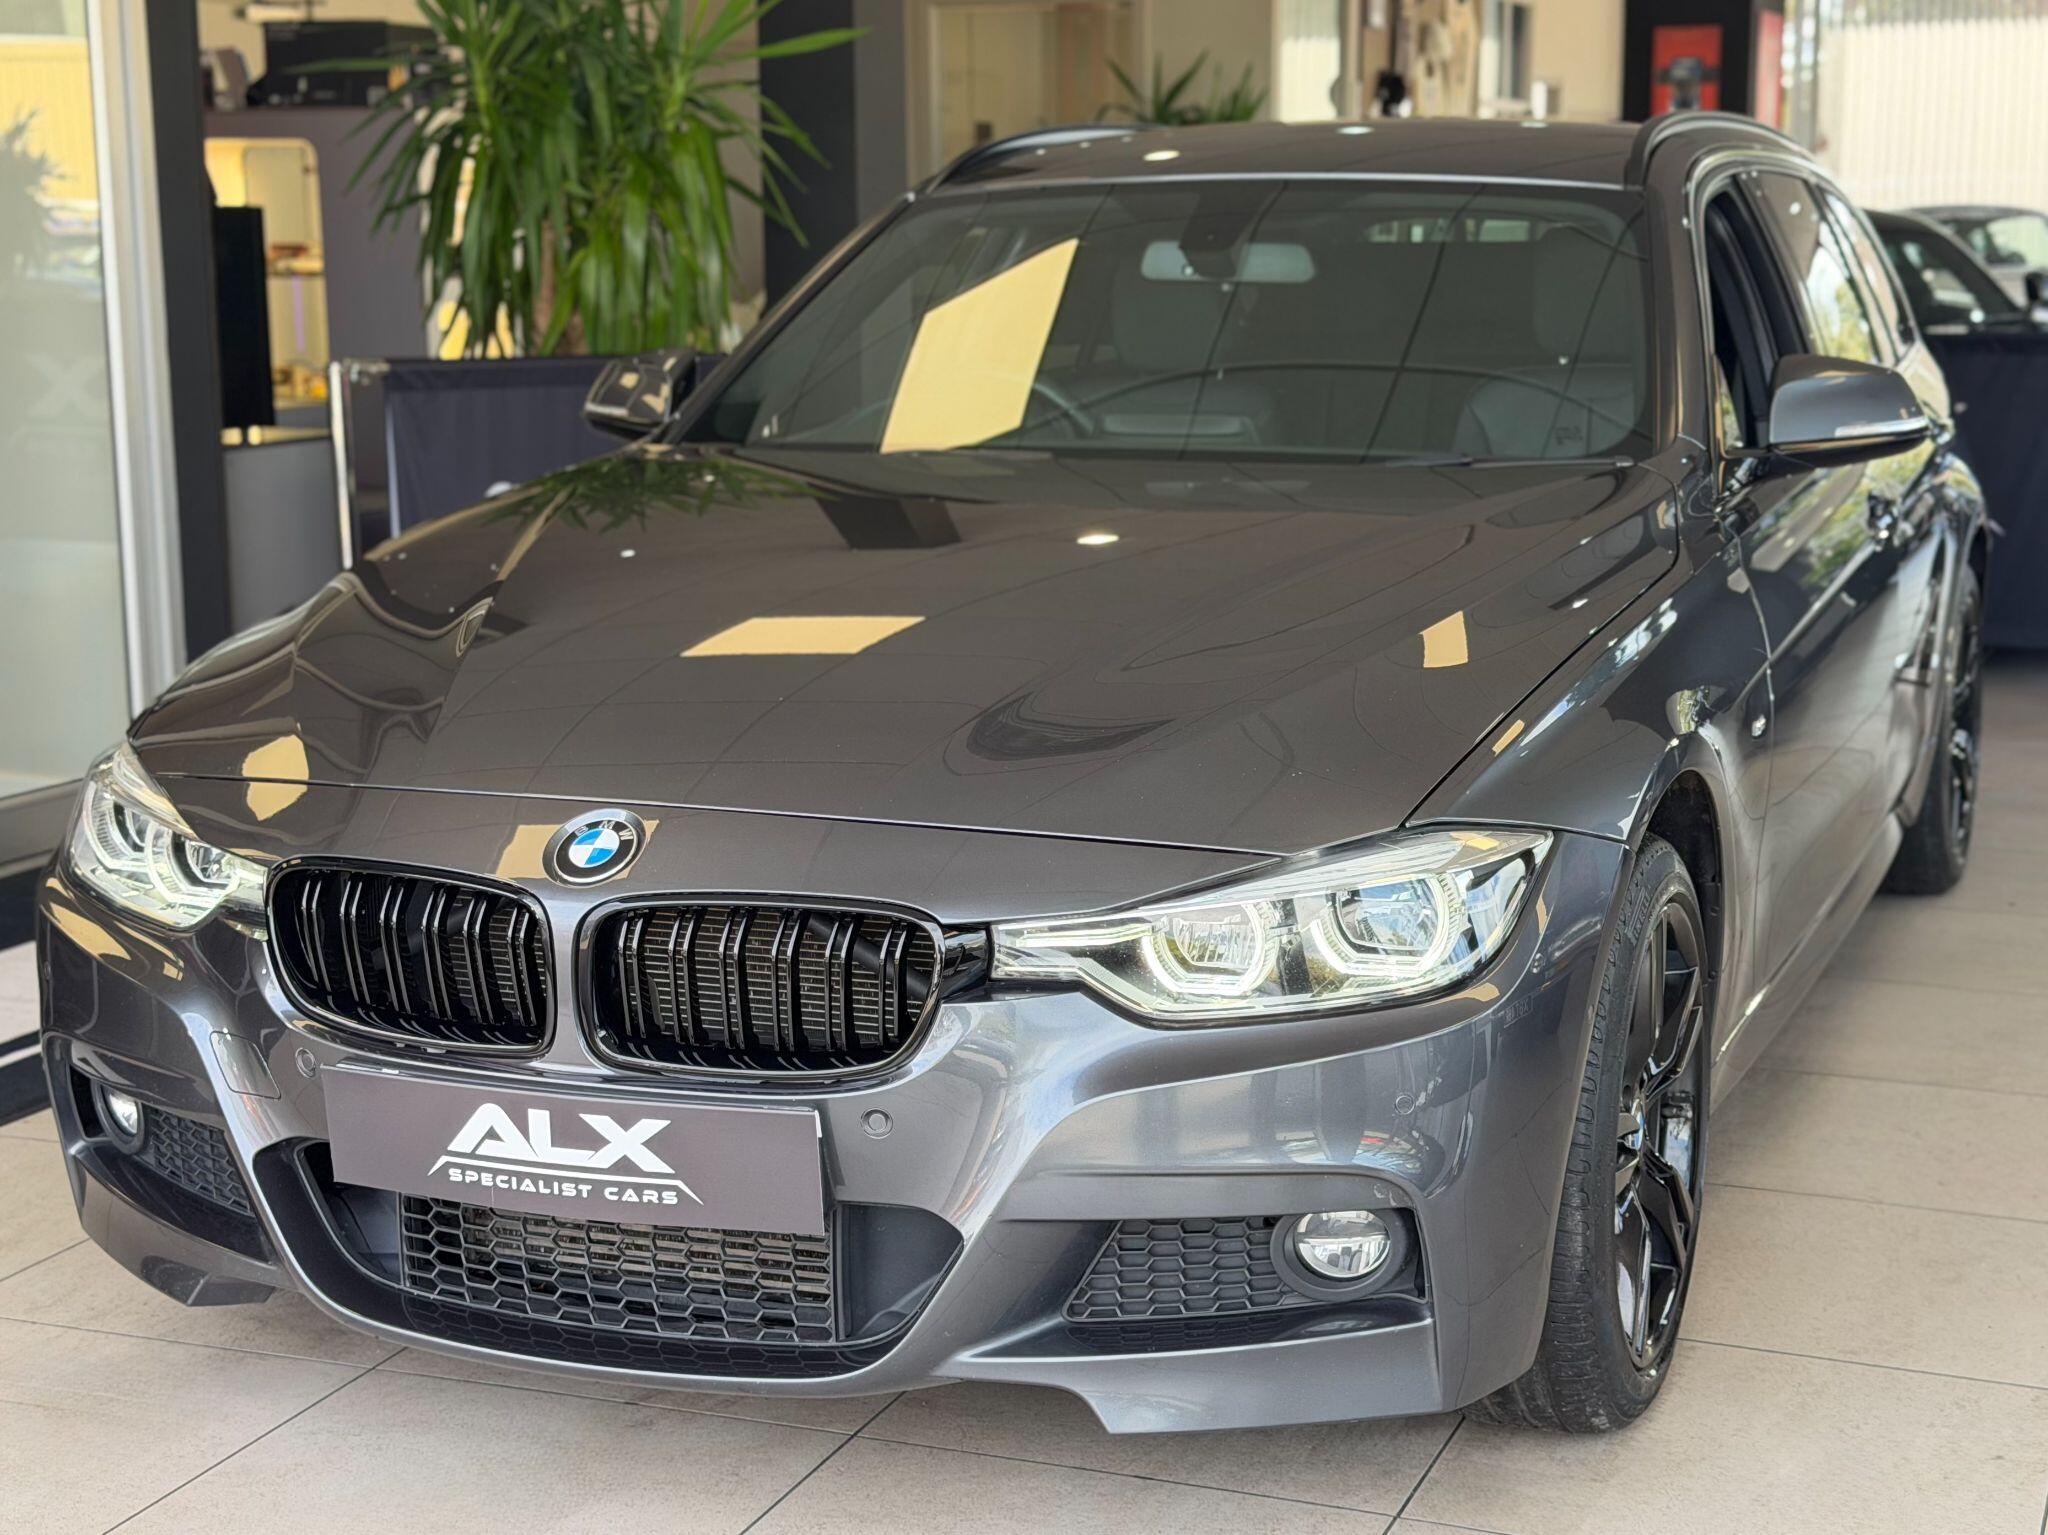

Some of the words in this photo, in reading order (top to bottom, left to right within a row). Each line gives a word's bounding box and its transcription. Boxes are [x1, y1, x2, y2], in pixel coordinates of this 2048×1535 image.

[574, 820, 634, 841] BMW
[447, 1103, 676, 1174] ALX
[448, 1168, 593, 1198] SPECIALIST
[603, 1187, 679, 1205] CARS
